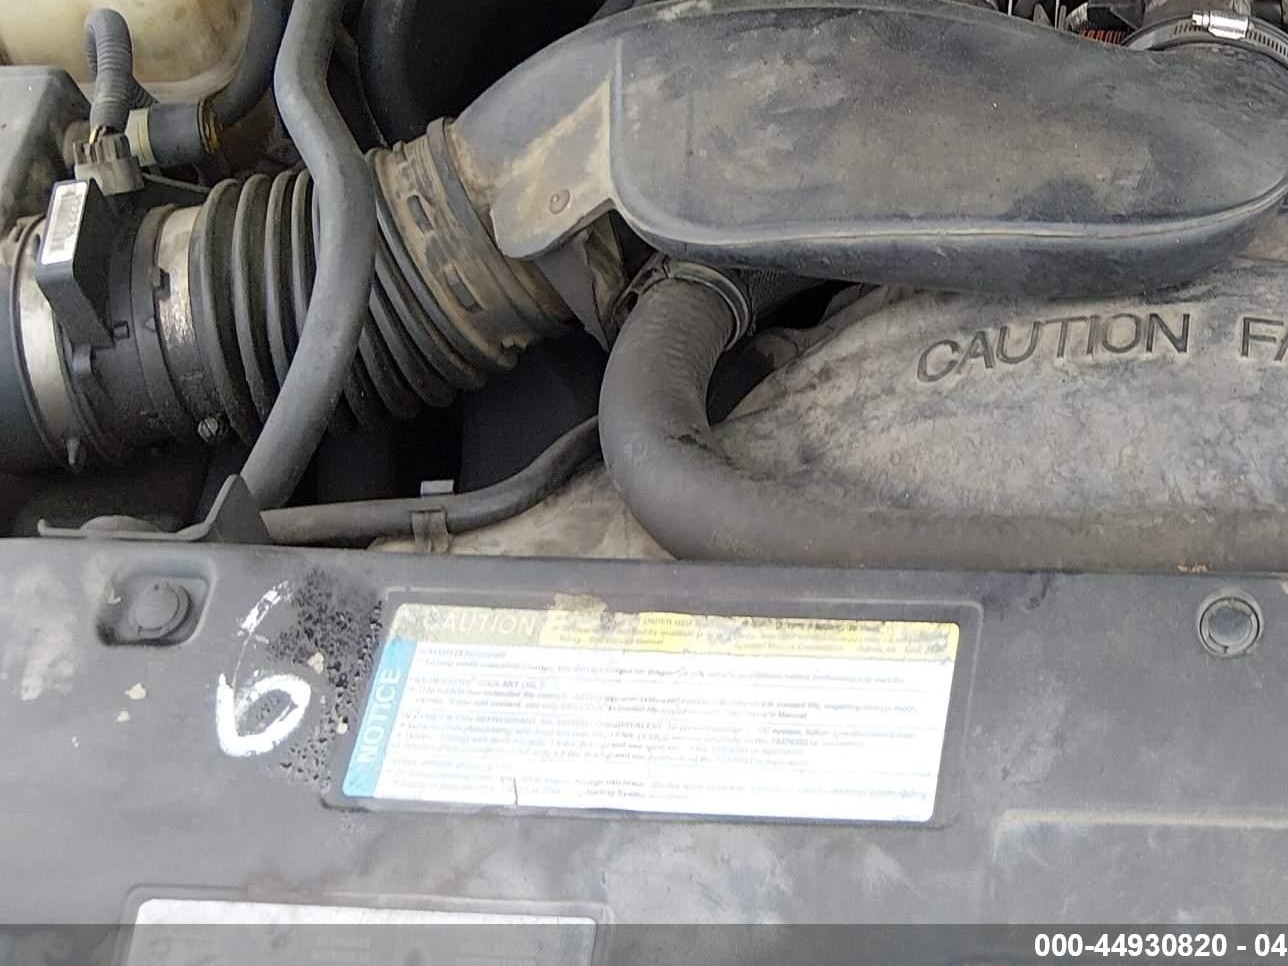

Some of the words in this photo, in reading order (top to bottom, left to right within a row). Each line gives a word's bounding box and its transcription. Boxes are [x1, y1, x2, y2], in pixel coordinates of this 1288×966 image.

[916, 311, 1191, 384] CAUTION
[423, 611, 536, 636] CAUTION
[356, 666, 401, 763] NOTICE
